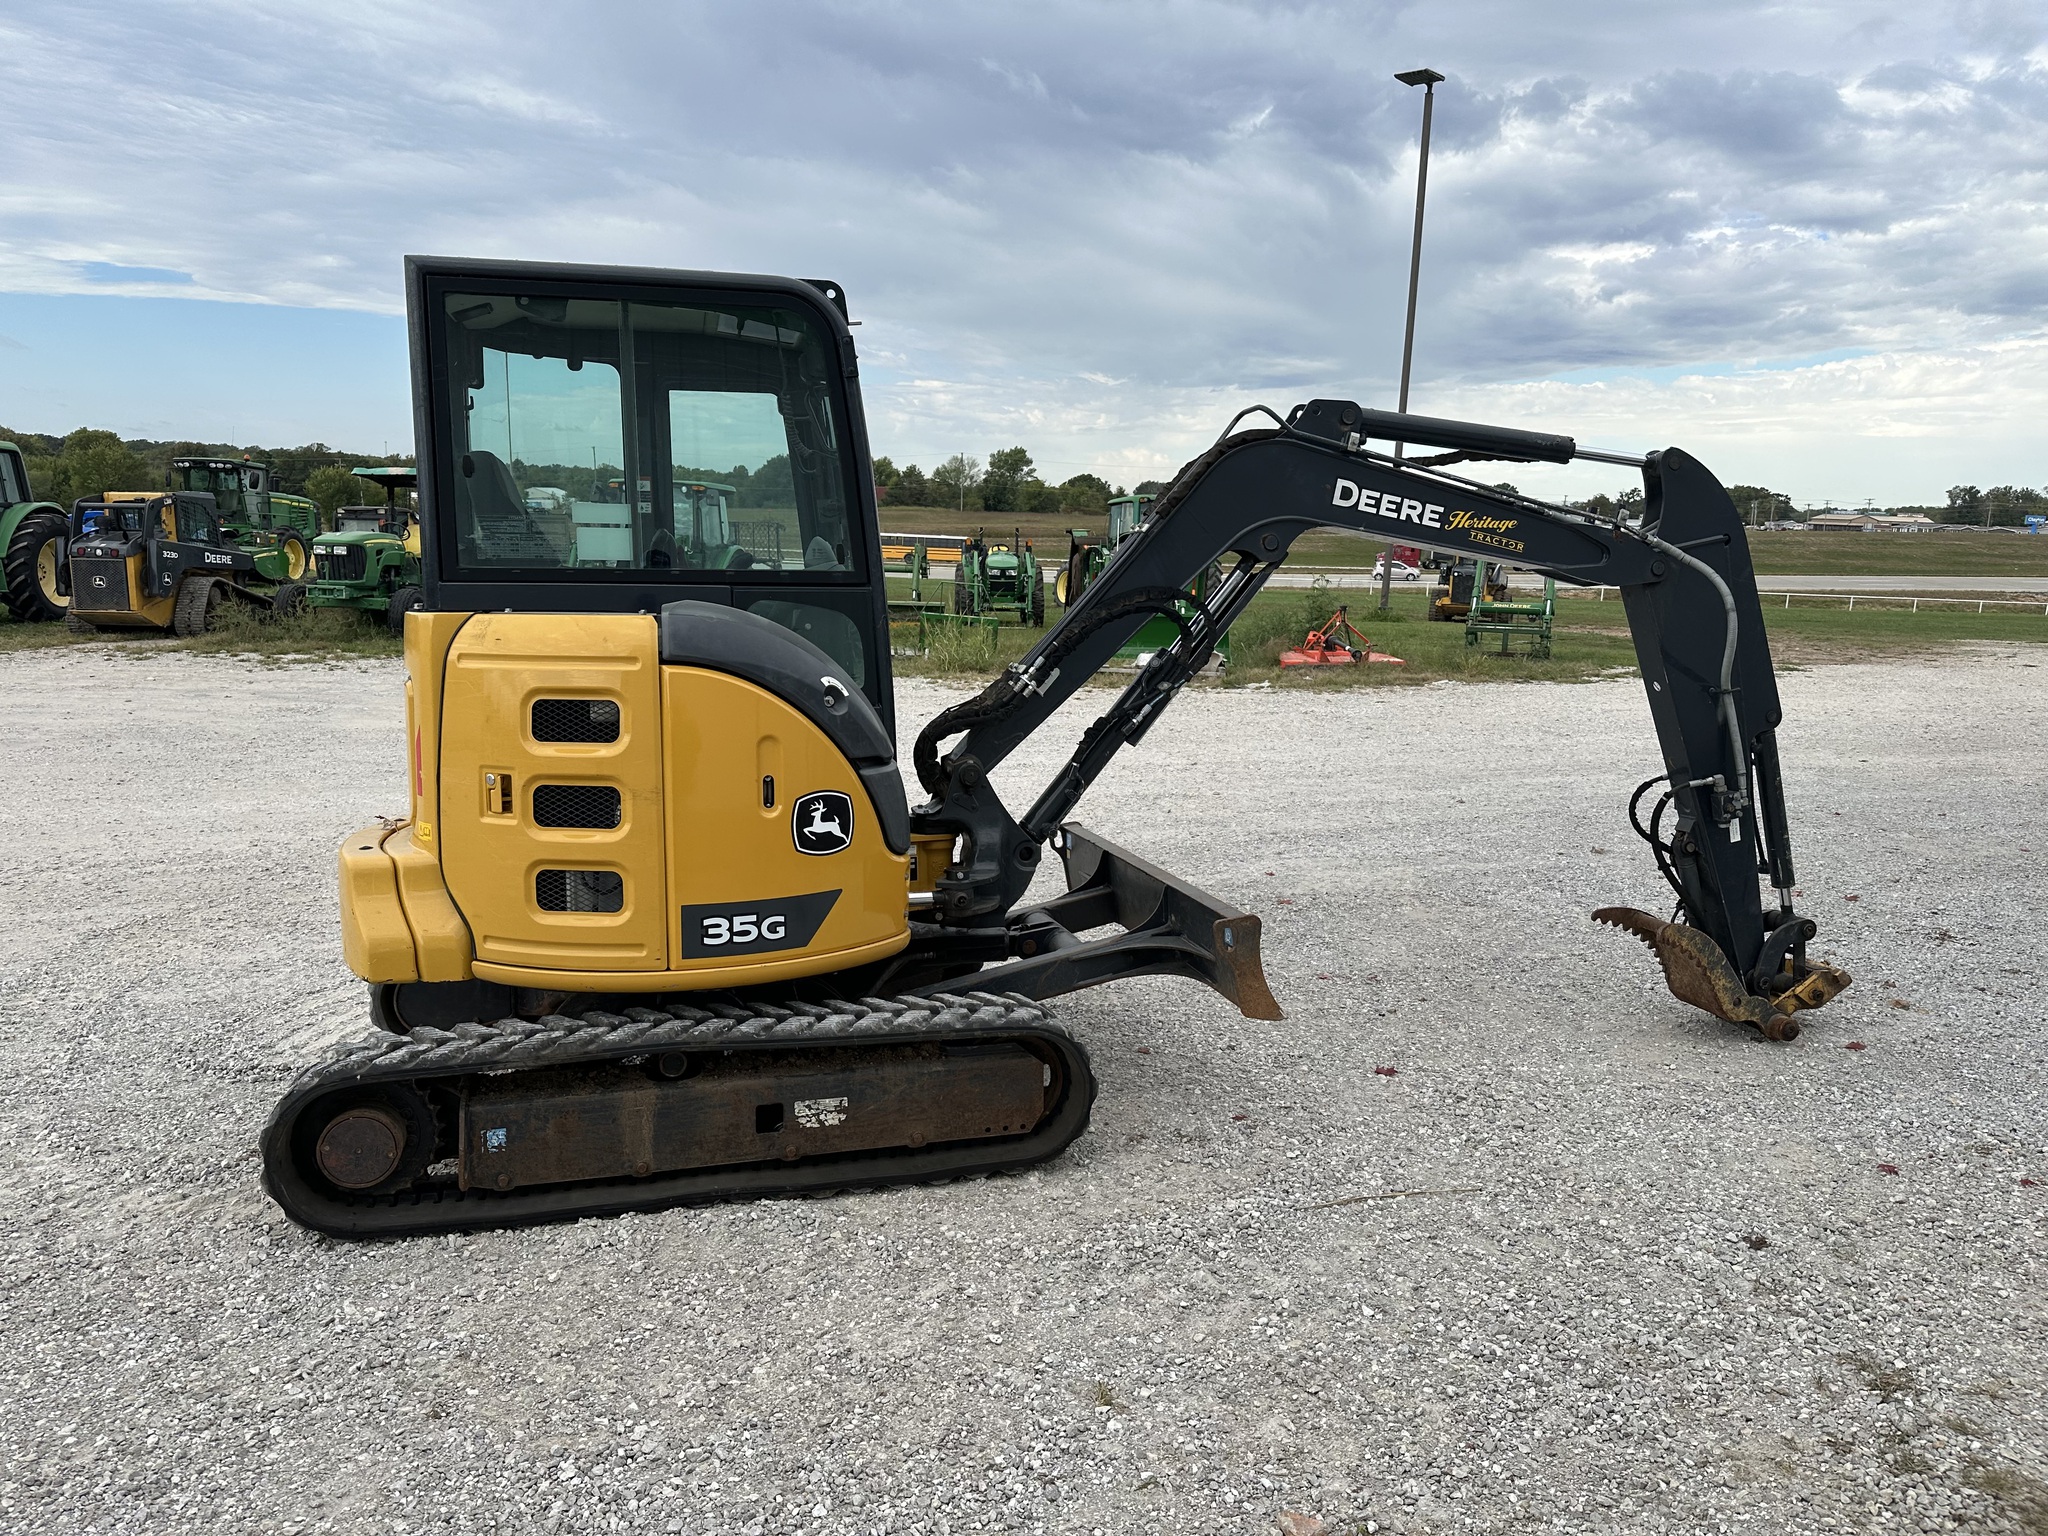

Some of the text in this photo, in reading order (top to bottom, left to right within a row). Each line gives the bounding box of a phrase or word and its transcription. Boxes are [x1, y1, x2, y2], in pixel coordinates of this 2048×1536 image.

[1332, 478, 1519, 533] DEERE Heritage
[1469, 531, 1526, 551] TRACTOR
[162, 550, 179, 559] 323D
[204, 551, 233, 565] DEERE
[703, 914, 785, 945] 35G
